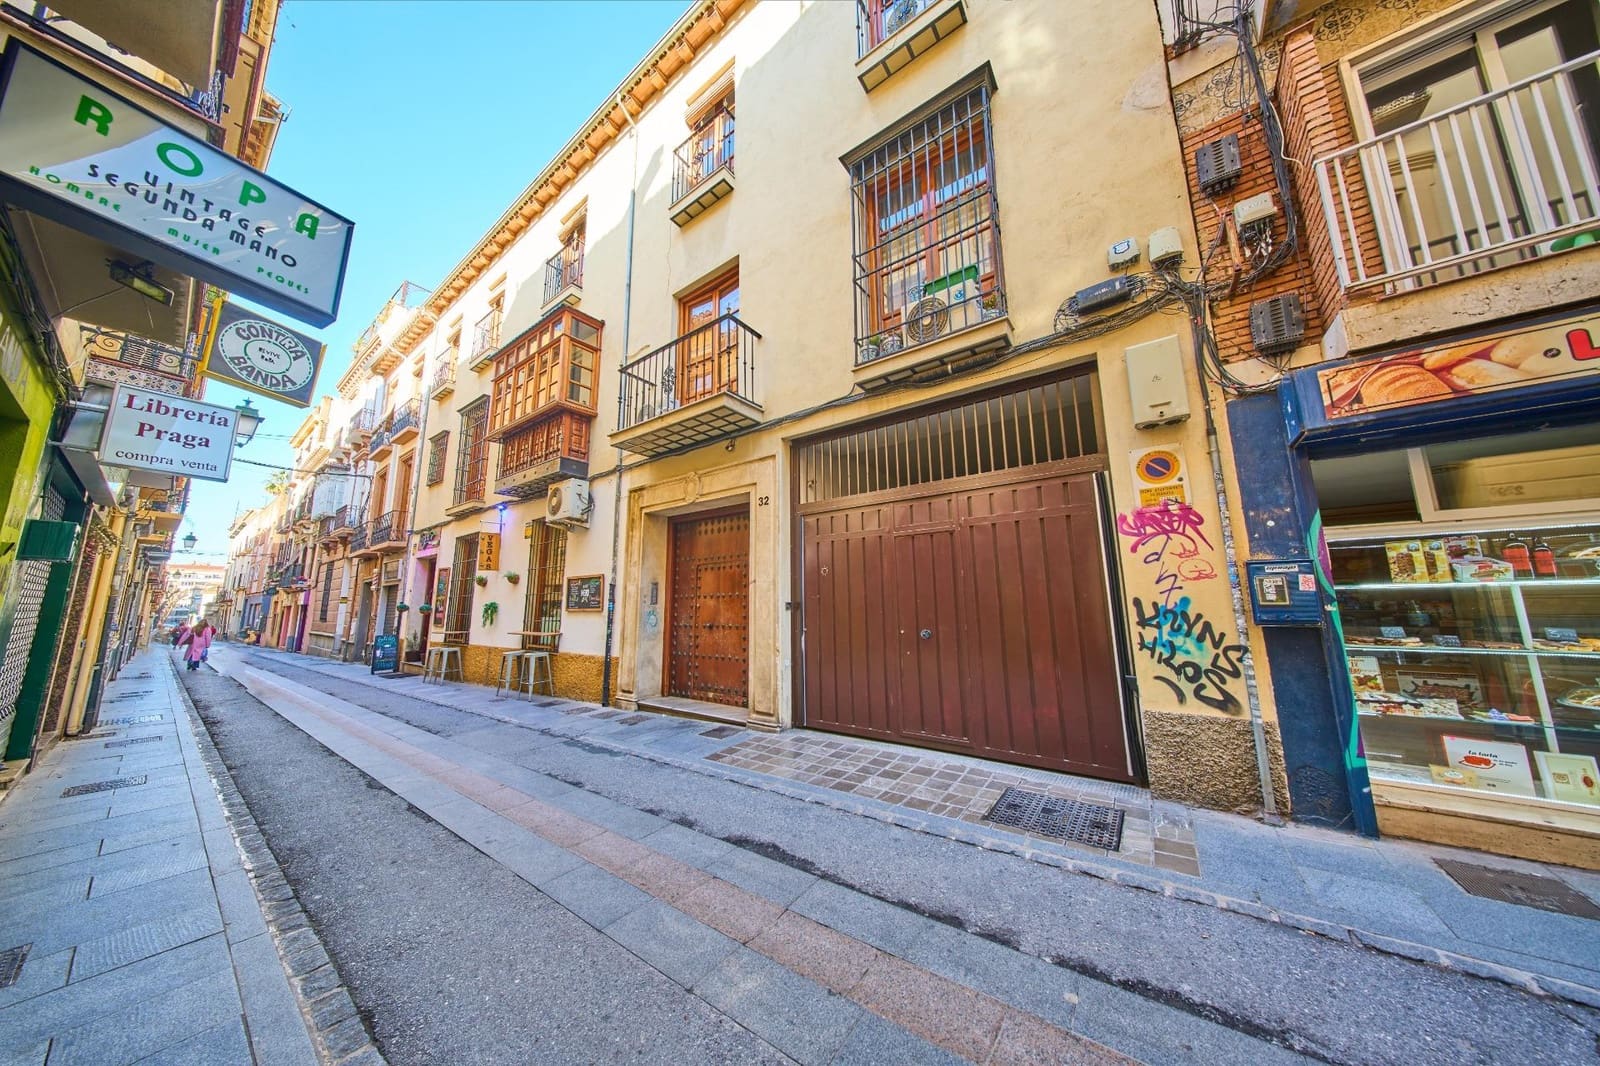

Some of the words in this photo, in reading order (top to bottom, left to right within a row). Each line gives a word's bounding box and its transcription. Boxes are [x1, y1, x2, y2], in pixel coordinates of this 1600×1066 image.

[74, 94, 319, 240] ROPA
[29, 165, 121, 212] HOMBRE
[167, 227, 221, 256] MUJER
[256, 265, 309, 294] PEQUES
[87, 163, 215, 232] SEGUNDA
[229, 229, 297, 267] MANO
[235, 324, 307, 362] CONTRA
[228, 356, 297, 388] BANDA
[123, 393, 230, 427] Librería
[136, 422, 210, 449] Praga
[115, 450, 174, 465] compra
[181, 460, 218, 471] venta
[758, 495, 770, 506] 32
[486, 535, 494, 570] VEGAS
